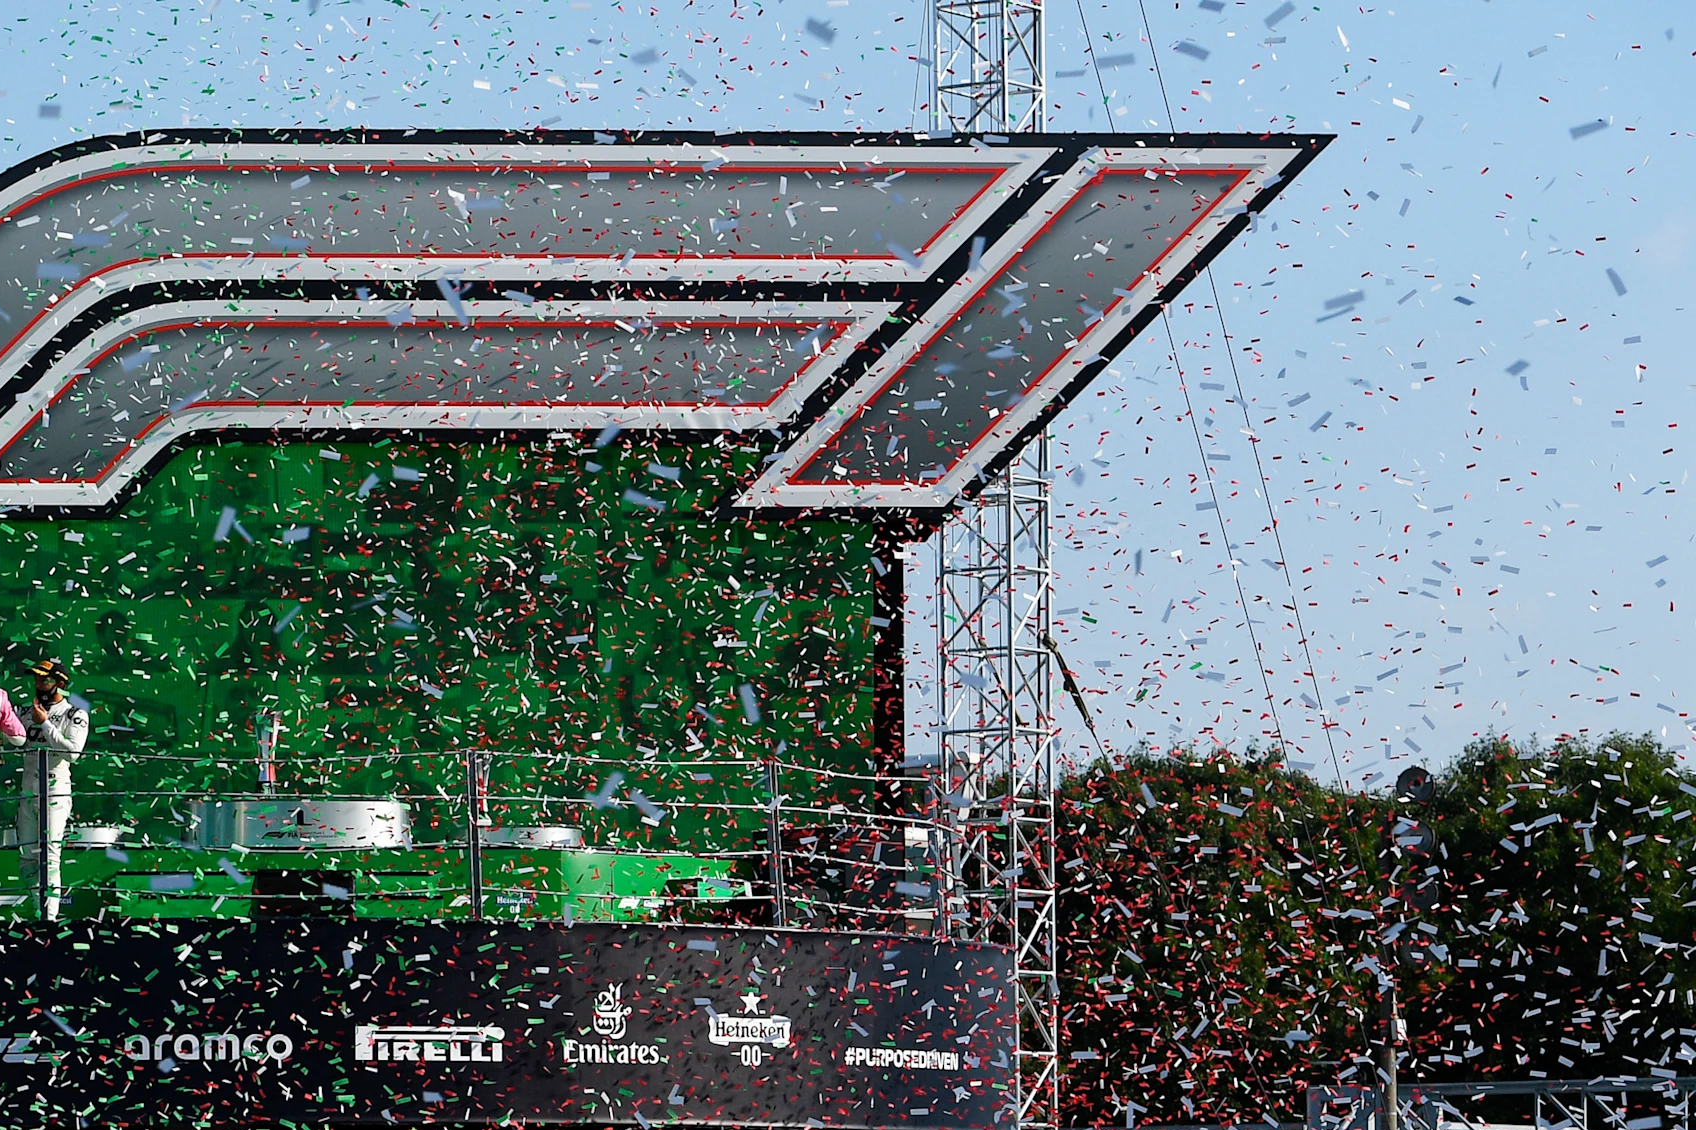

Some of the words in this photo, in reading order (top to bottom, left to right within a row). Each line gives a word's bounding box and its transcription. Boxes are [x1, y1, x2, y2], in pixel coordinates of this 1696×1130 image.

[715, 1020, 785, 1039] Heineken
[124, 1034, 292, 1061] aramco
[355, 1026, 504, 1062] PIRELLI
[562, 1038, 659, 1065] Emirates
